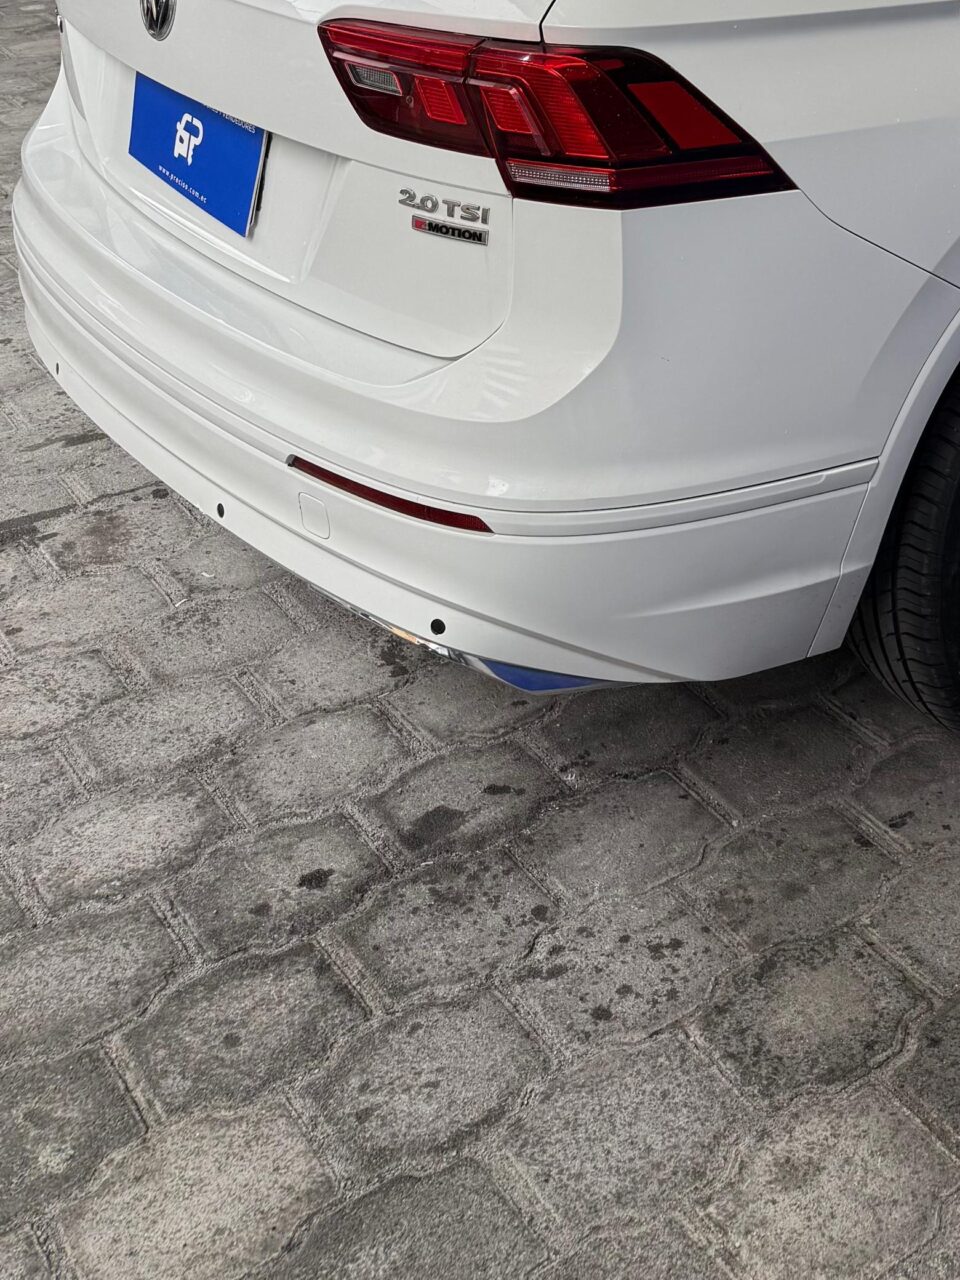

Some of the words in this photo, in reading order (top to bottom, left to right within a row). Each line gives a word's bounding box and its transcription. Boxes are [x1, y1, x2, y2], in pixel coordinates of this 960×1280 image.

[158, 164, 207, 204] www.preciso.com.ec
[398, 187, 440, 214] 2.0
[442, 199, 491, 225] TSI
